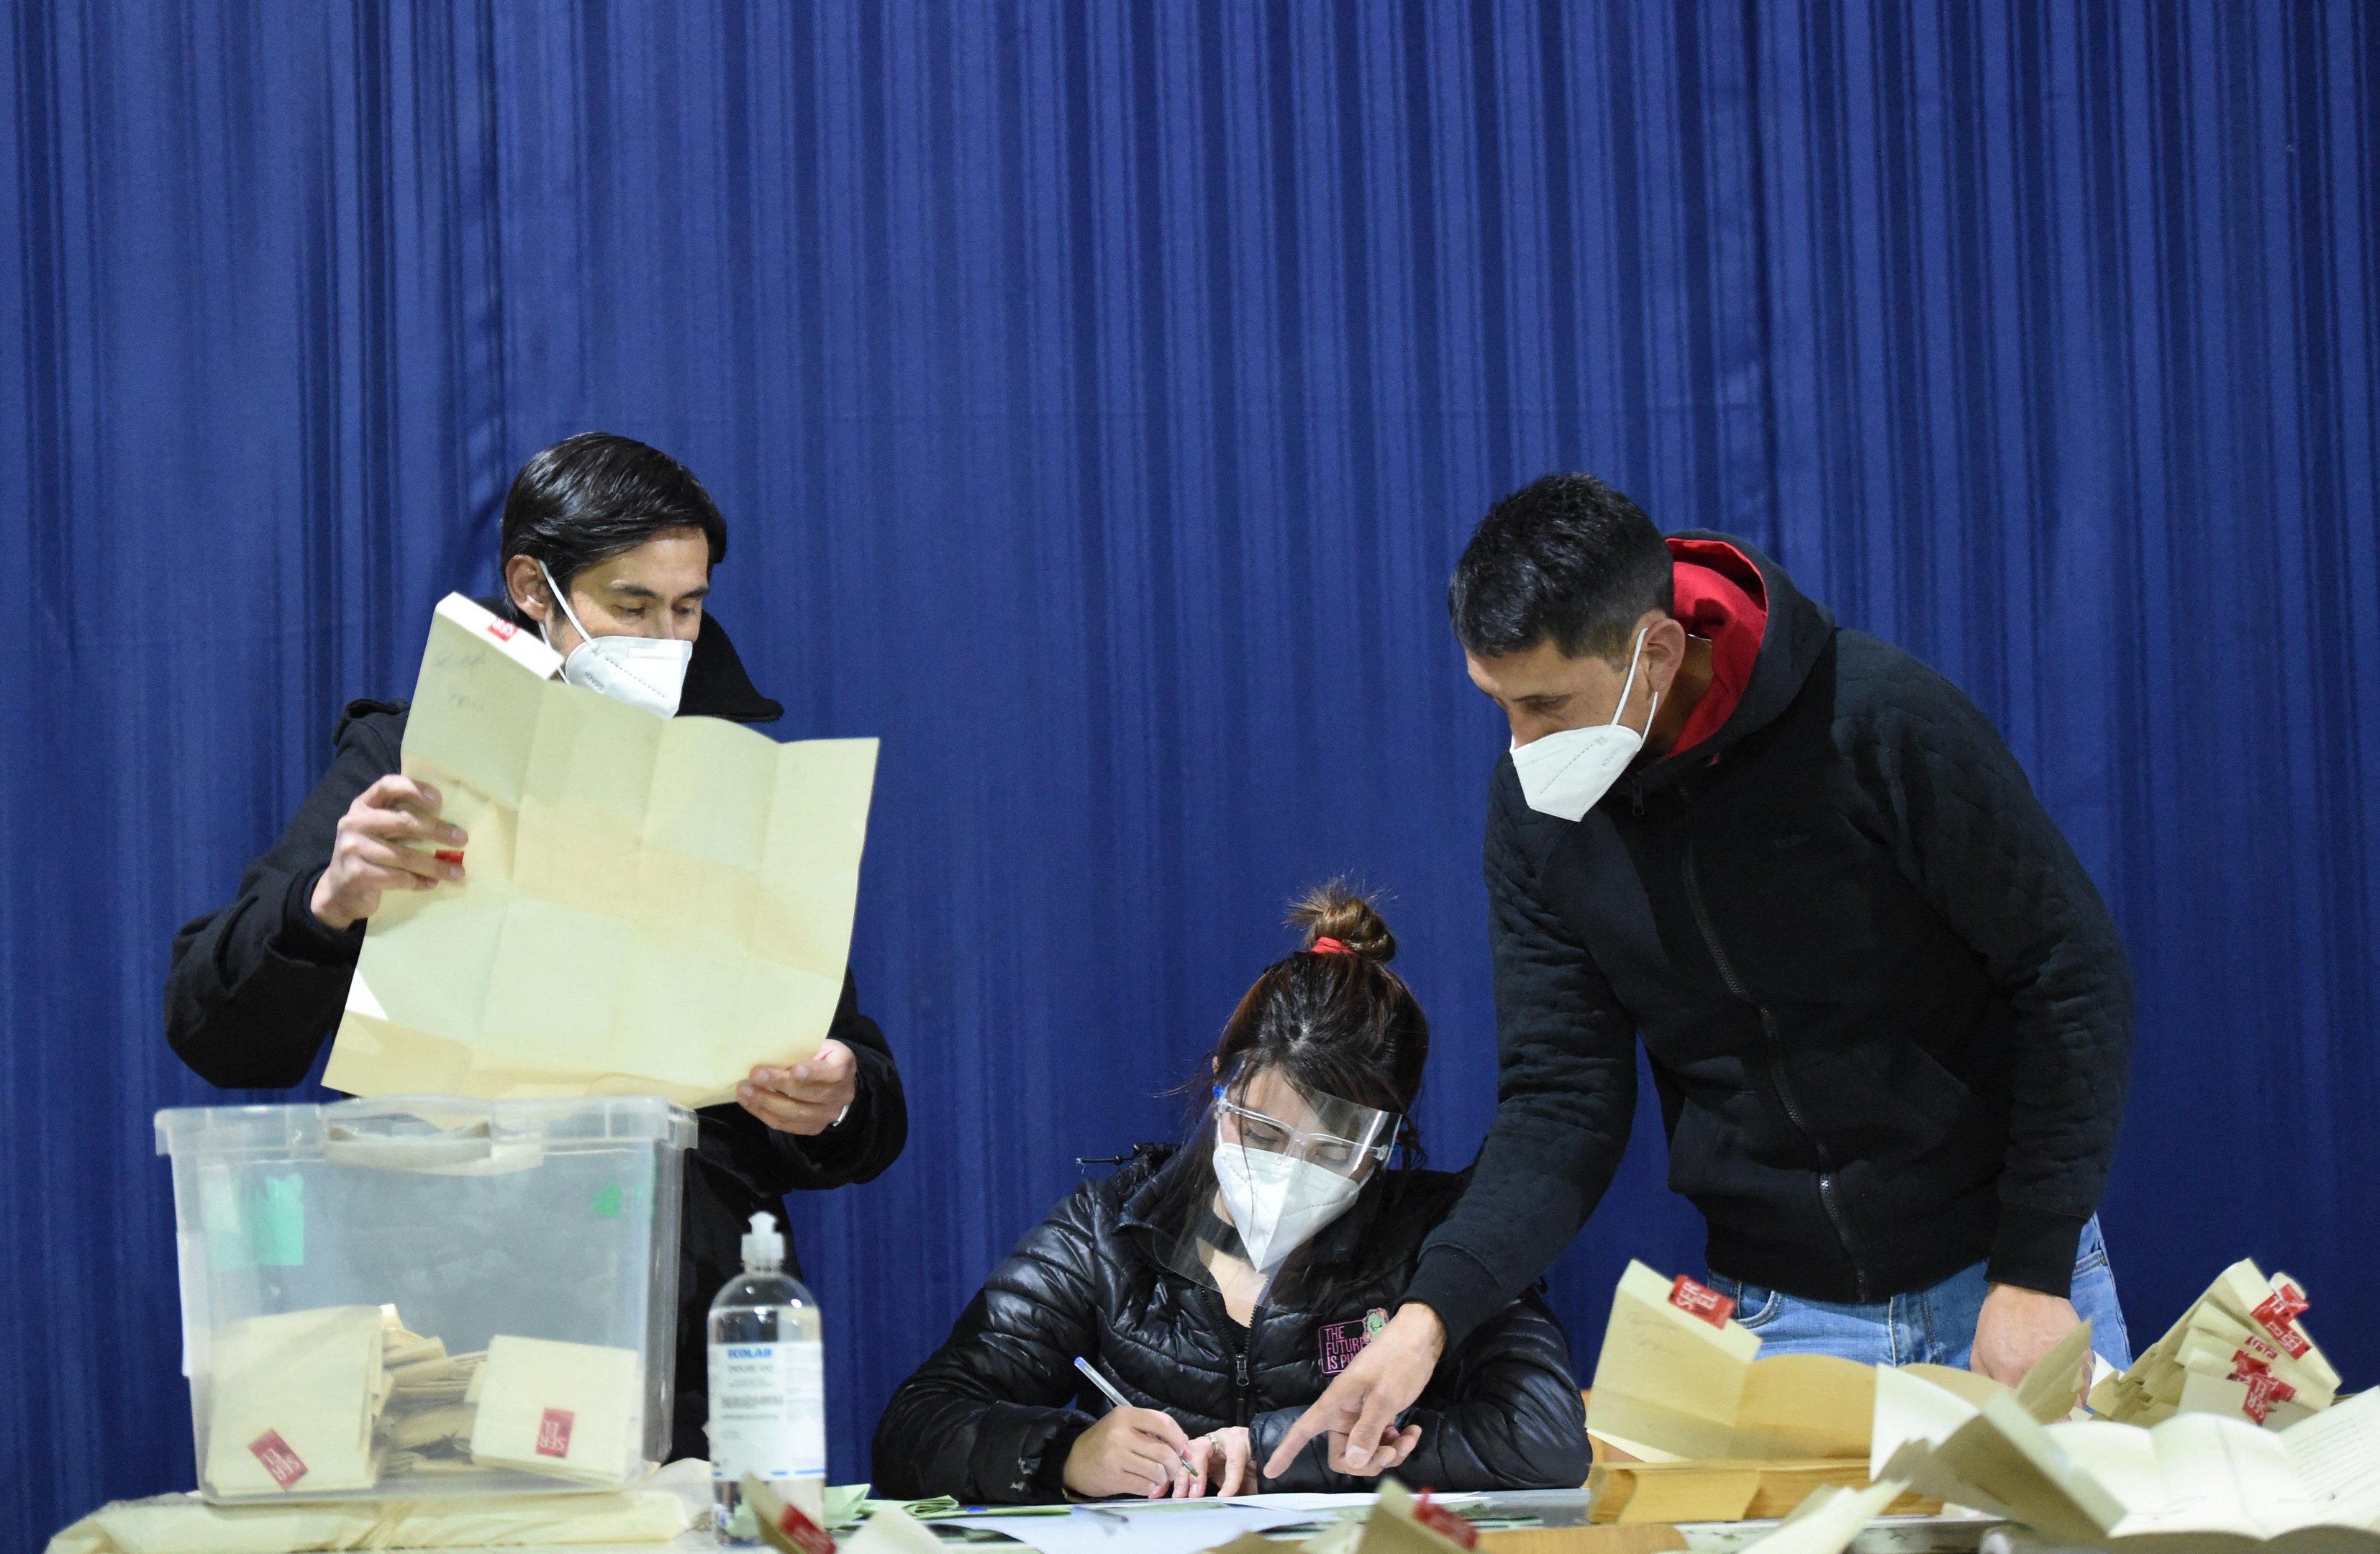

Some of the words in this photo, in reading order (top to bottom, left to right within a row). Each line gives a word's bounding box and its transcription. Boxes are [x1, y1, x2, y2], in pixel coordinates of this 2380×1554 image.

[1675, 1281, 1700, 1311] SER
[1324, 1326, 1345, 1341] THE
[2279, 1330, 2302, 1353] SER
[1327, 1355, 1337, 1370] IS
[1340, 1352, 1358, 1368] PIN
[540, 1434, 567, 1452] SER
[271, 1455, 301, 1482] SER
